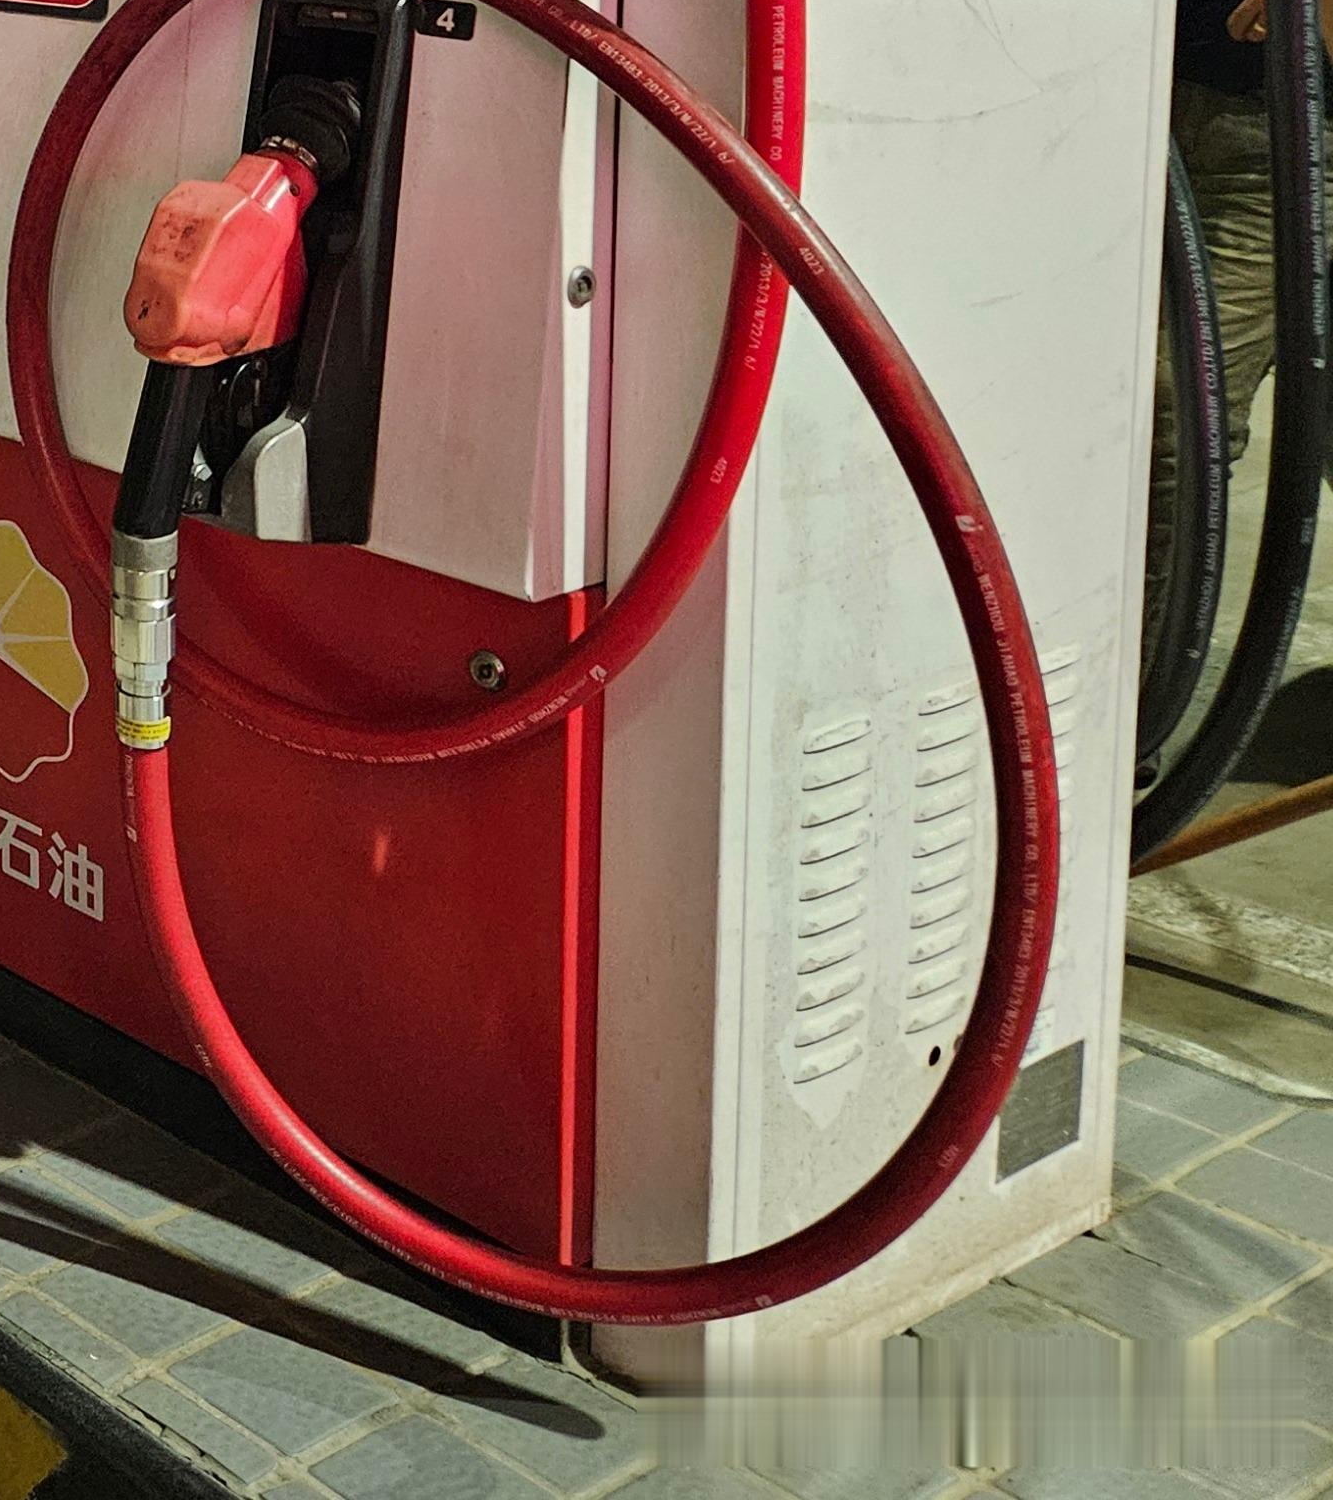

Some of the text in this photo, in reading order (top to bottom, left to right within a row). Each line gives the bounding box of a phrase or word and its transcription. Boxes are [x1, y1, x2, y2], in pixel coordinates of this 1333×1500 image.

[435, 8, 456, 32] 4
[772, 4, 785, 71] PETROLEUM
[770, 75, 785, 141] MACHINERY
